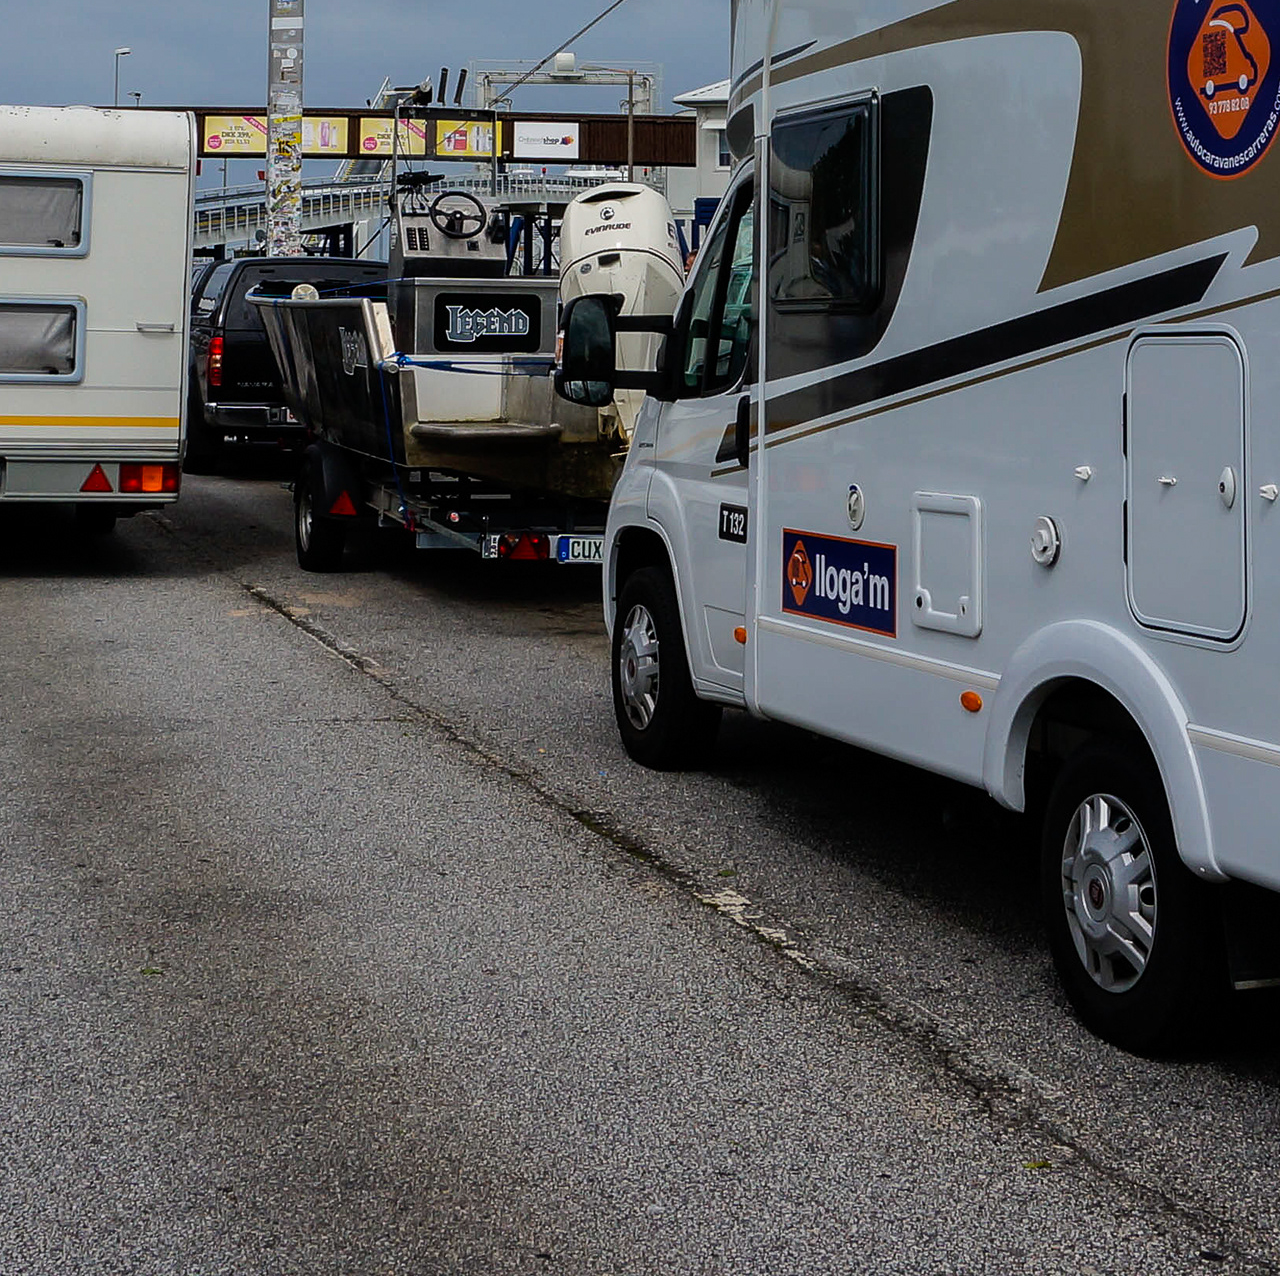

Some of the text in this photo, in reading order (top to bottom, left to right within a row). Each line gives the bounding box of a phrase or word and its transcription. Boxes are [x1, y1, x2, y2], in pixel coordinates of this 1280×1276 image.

[584, 222, 632, 237] EVINRUDE
[445, 305, 530, 343] LEGEND
[722, 510, 745, 536] T 132
[570, 540, 603, 559] CUX
[815, 553, 890, 615] lloga'm
